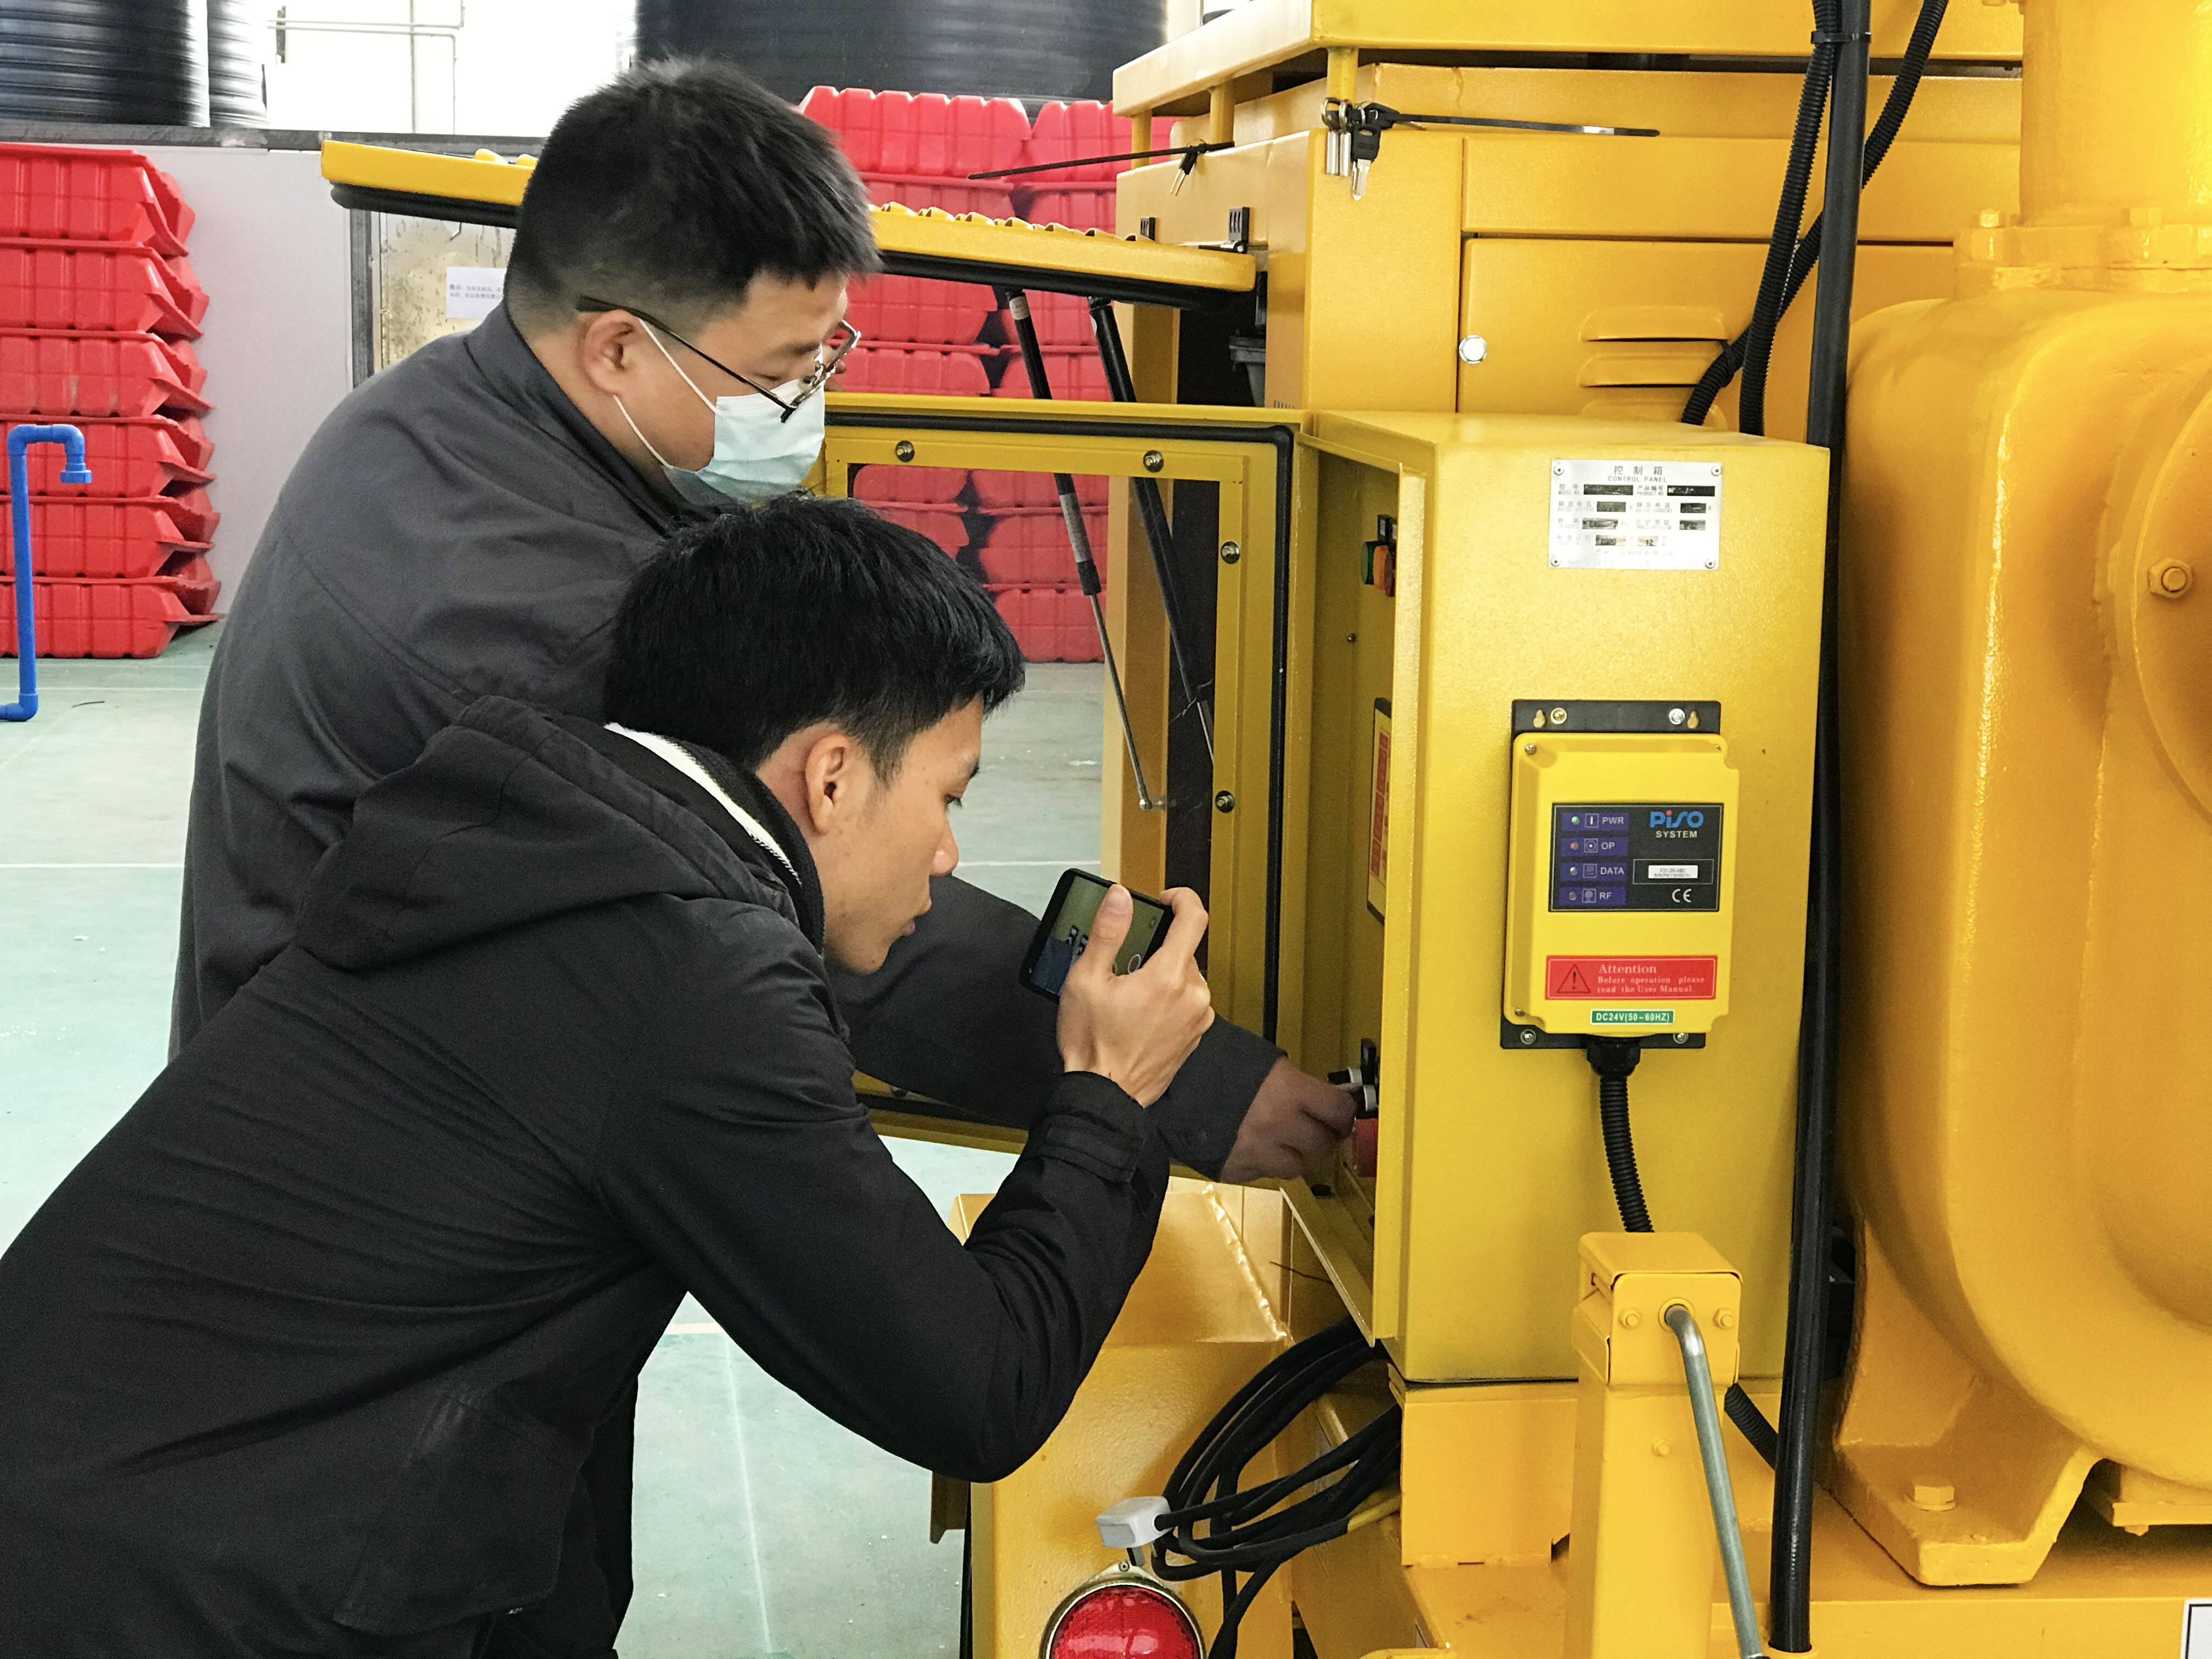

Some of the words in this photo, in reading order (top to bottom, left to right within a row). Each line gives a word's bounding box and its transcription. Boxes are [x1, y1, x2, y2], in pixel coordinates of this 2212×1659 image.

[1614, 465, 1662, 475] 控制箱
[1600, 867, 1624, 875] DATA
[1672, 889, 1692, 902] CE
[1599, 964, 1657, 974] Attention
